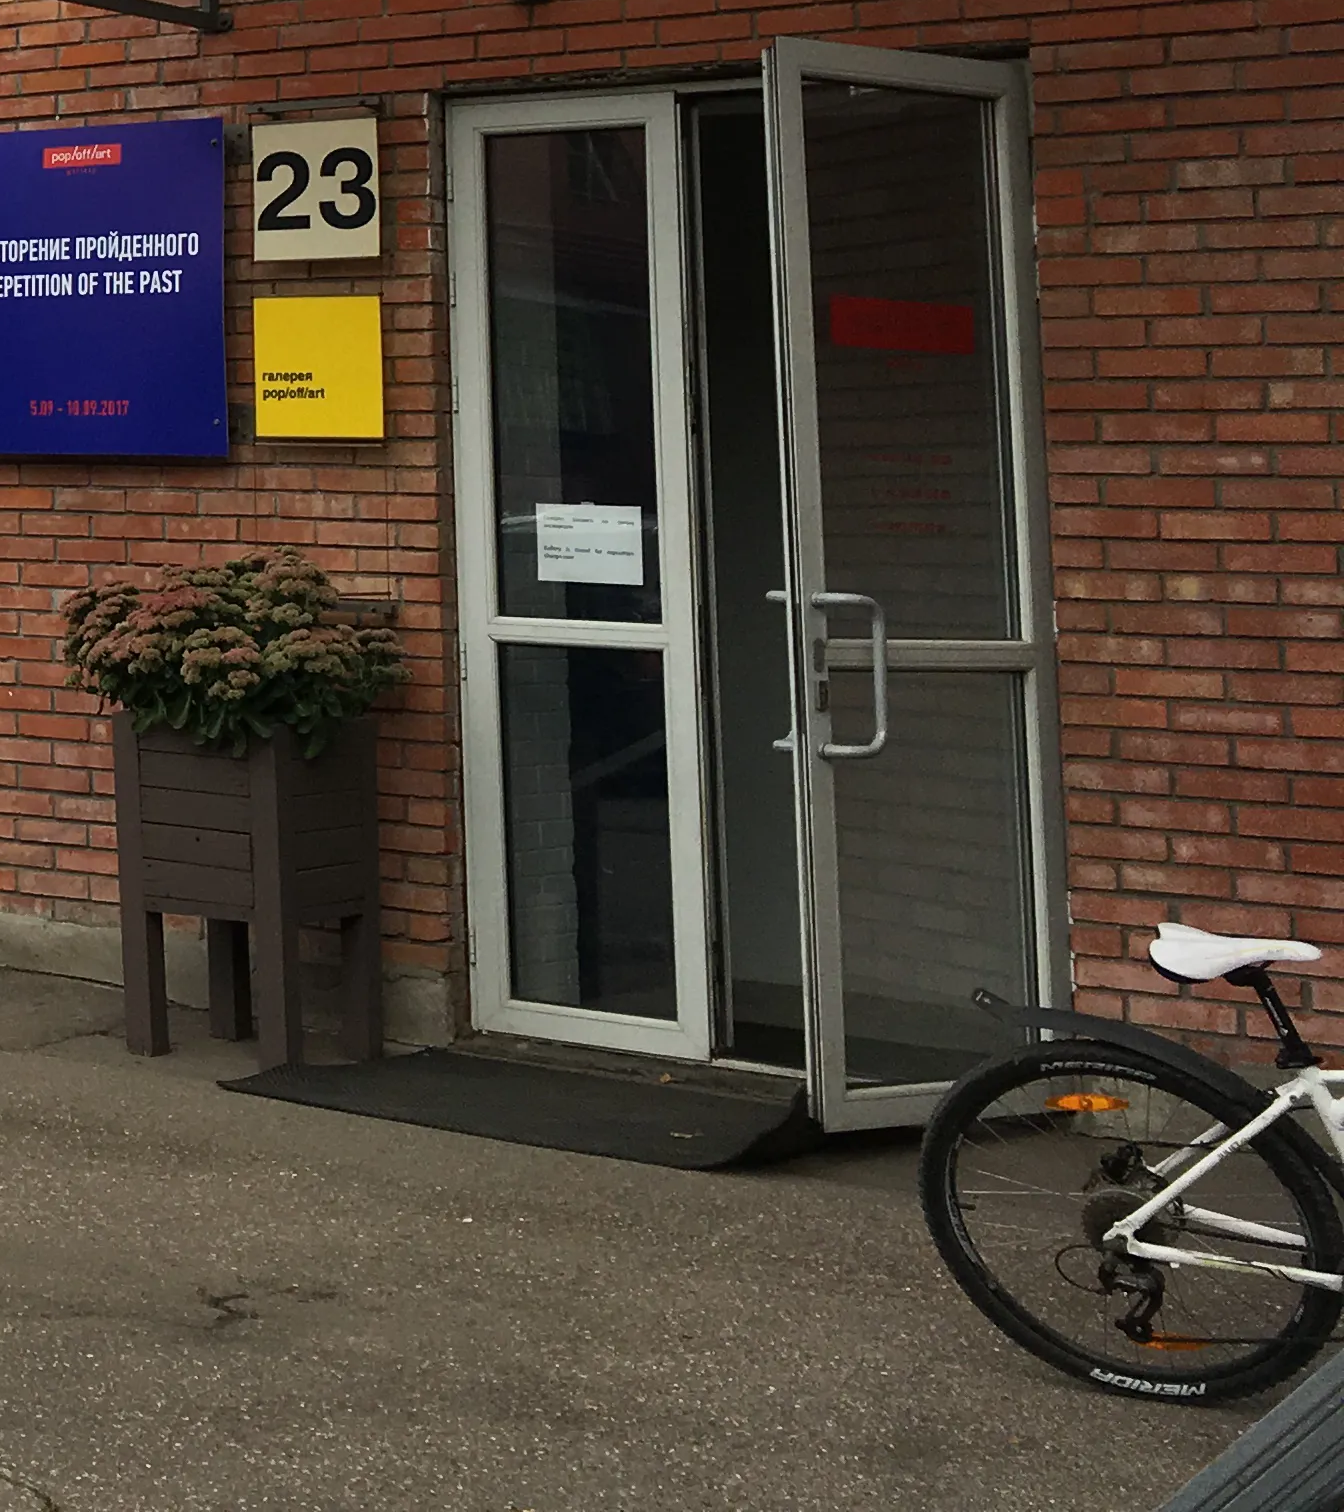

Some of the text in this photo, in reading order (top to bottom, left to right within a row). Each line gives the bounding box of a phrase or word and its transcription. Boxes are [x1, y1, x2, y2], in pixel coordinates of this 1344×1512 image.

[52, 145, 111, 164] pop/off/art
[257, 147, 376, 231] 23
[76, 231, 198, 261] ПРОЙДЕННОГО
[78, 273, 98, 295] OF
[103, 272, 134, 294] THE
[139, 270, 182, 293] PAST
[262, 372, 312, 384] галерея
[263, 387, 325, 400] pop/off/art
[1090, 1368, 1206, 1396] MERIDA
